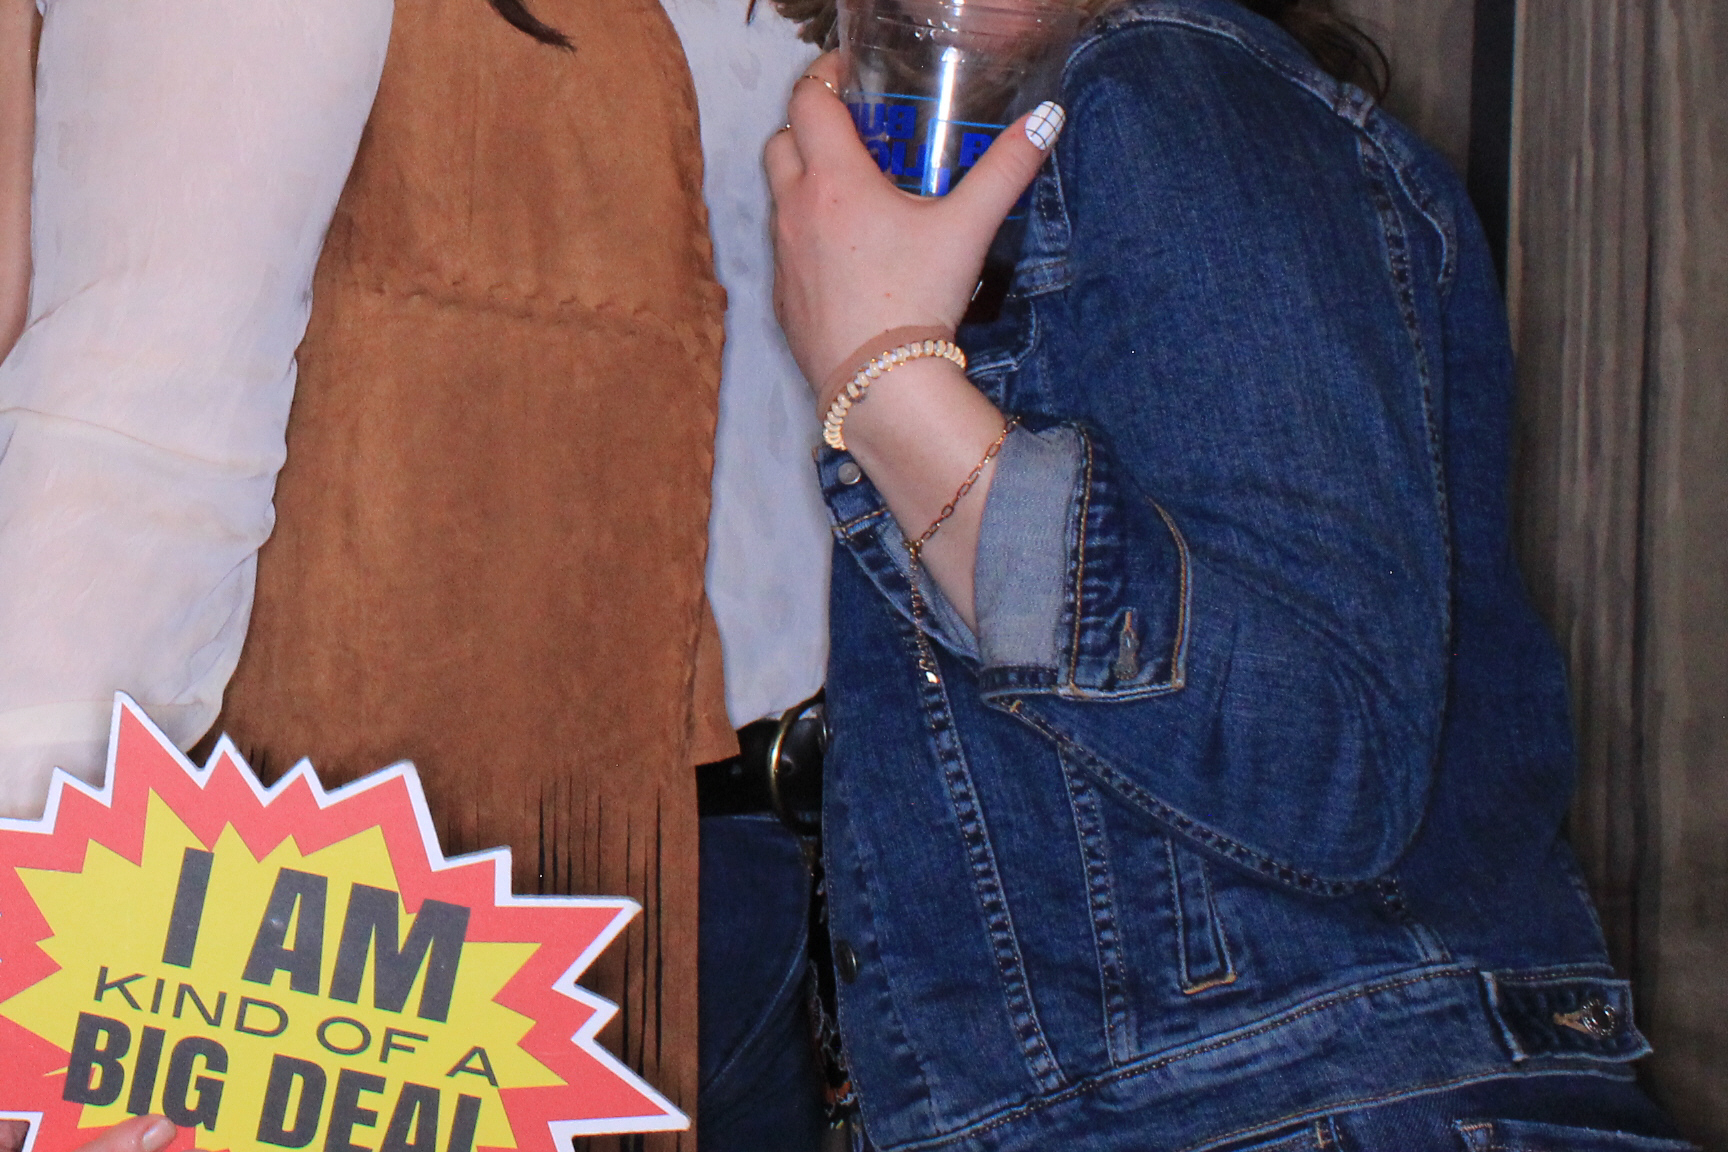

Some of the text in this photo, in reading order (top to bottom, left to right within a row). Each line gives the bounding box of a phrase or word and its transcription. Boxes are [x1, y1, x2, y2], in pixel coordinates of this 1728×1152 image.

[162, 847, 471, 1024] I AM
[62, 1011, 229, 1132] BIG
[93, 966, 500, 1088] KIND OF A
